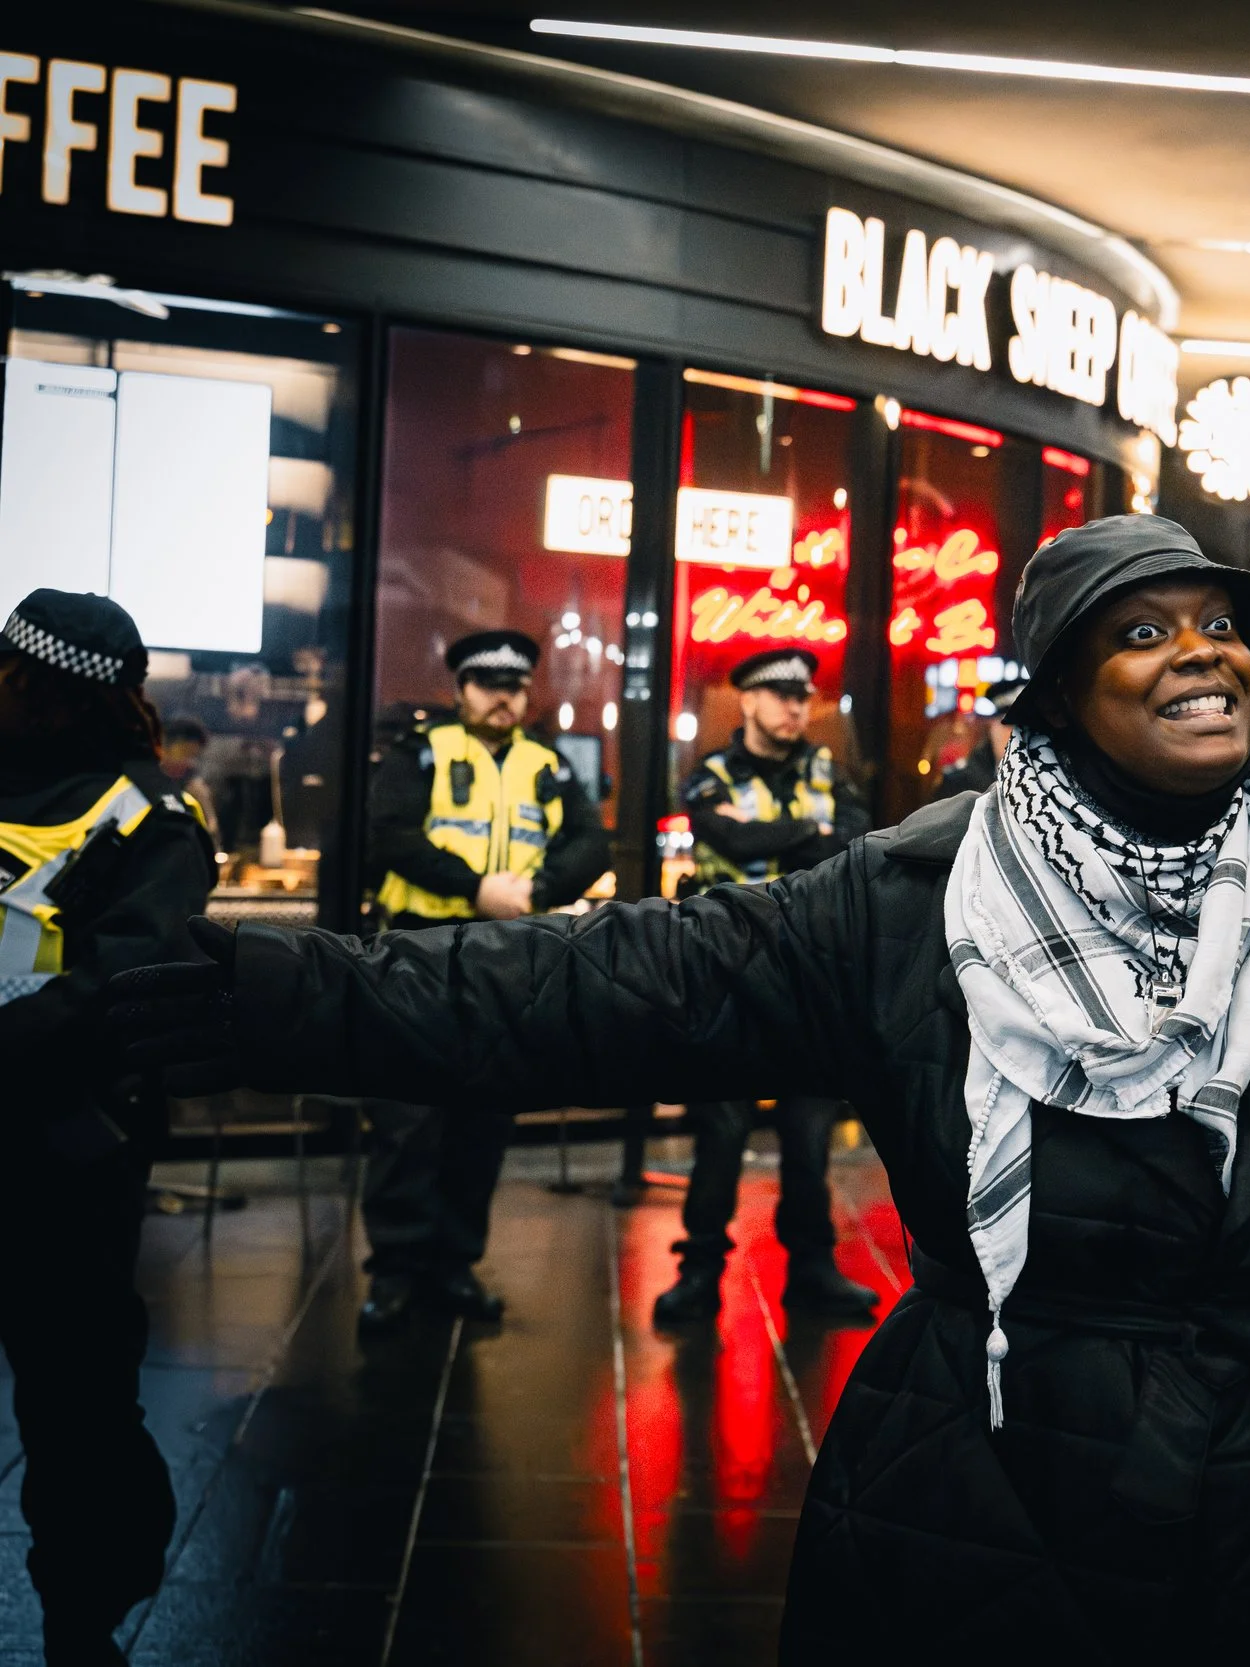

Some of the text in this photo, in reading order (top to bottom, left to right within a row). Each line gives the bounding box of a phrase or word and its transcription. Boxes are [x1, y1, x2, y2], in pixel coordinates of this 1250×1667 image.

[822, 206, 994, 371] BLACK
[1008, 264, 1117, 406] SHEEP
[578, 494, 632, 540] ORD
[692, 505, 760, 552] HERE
